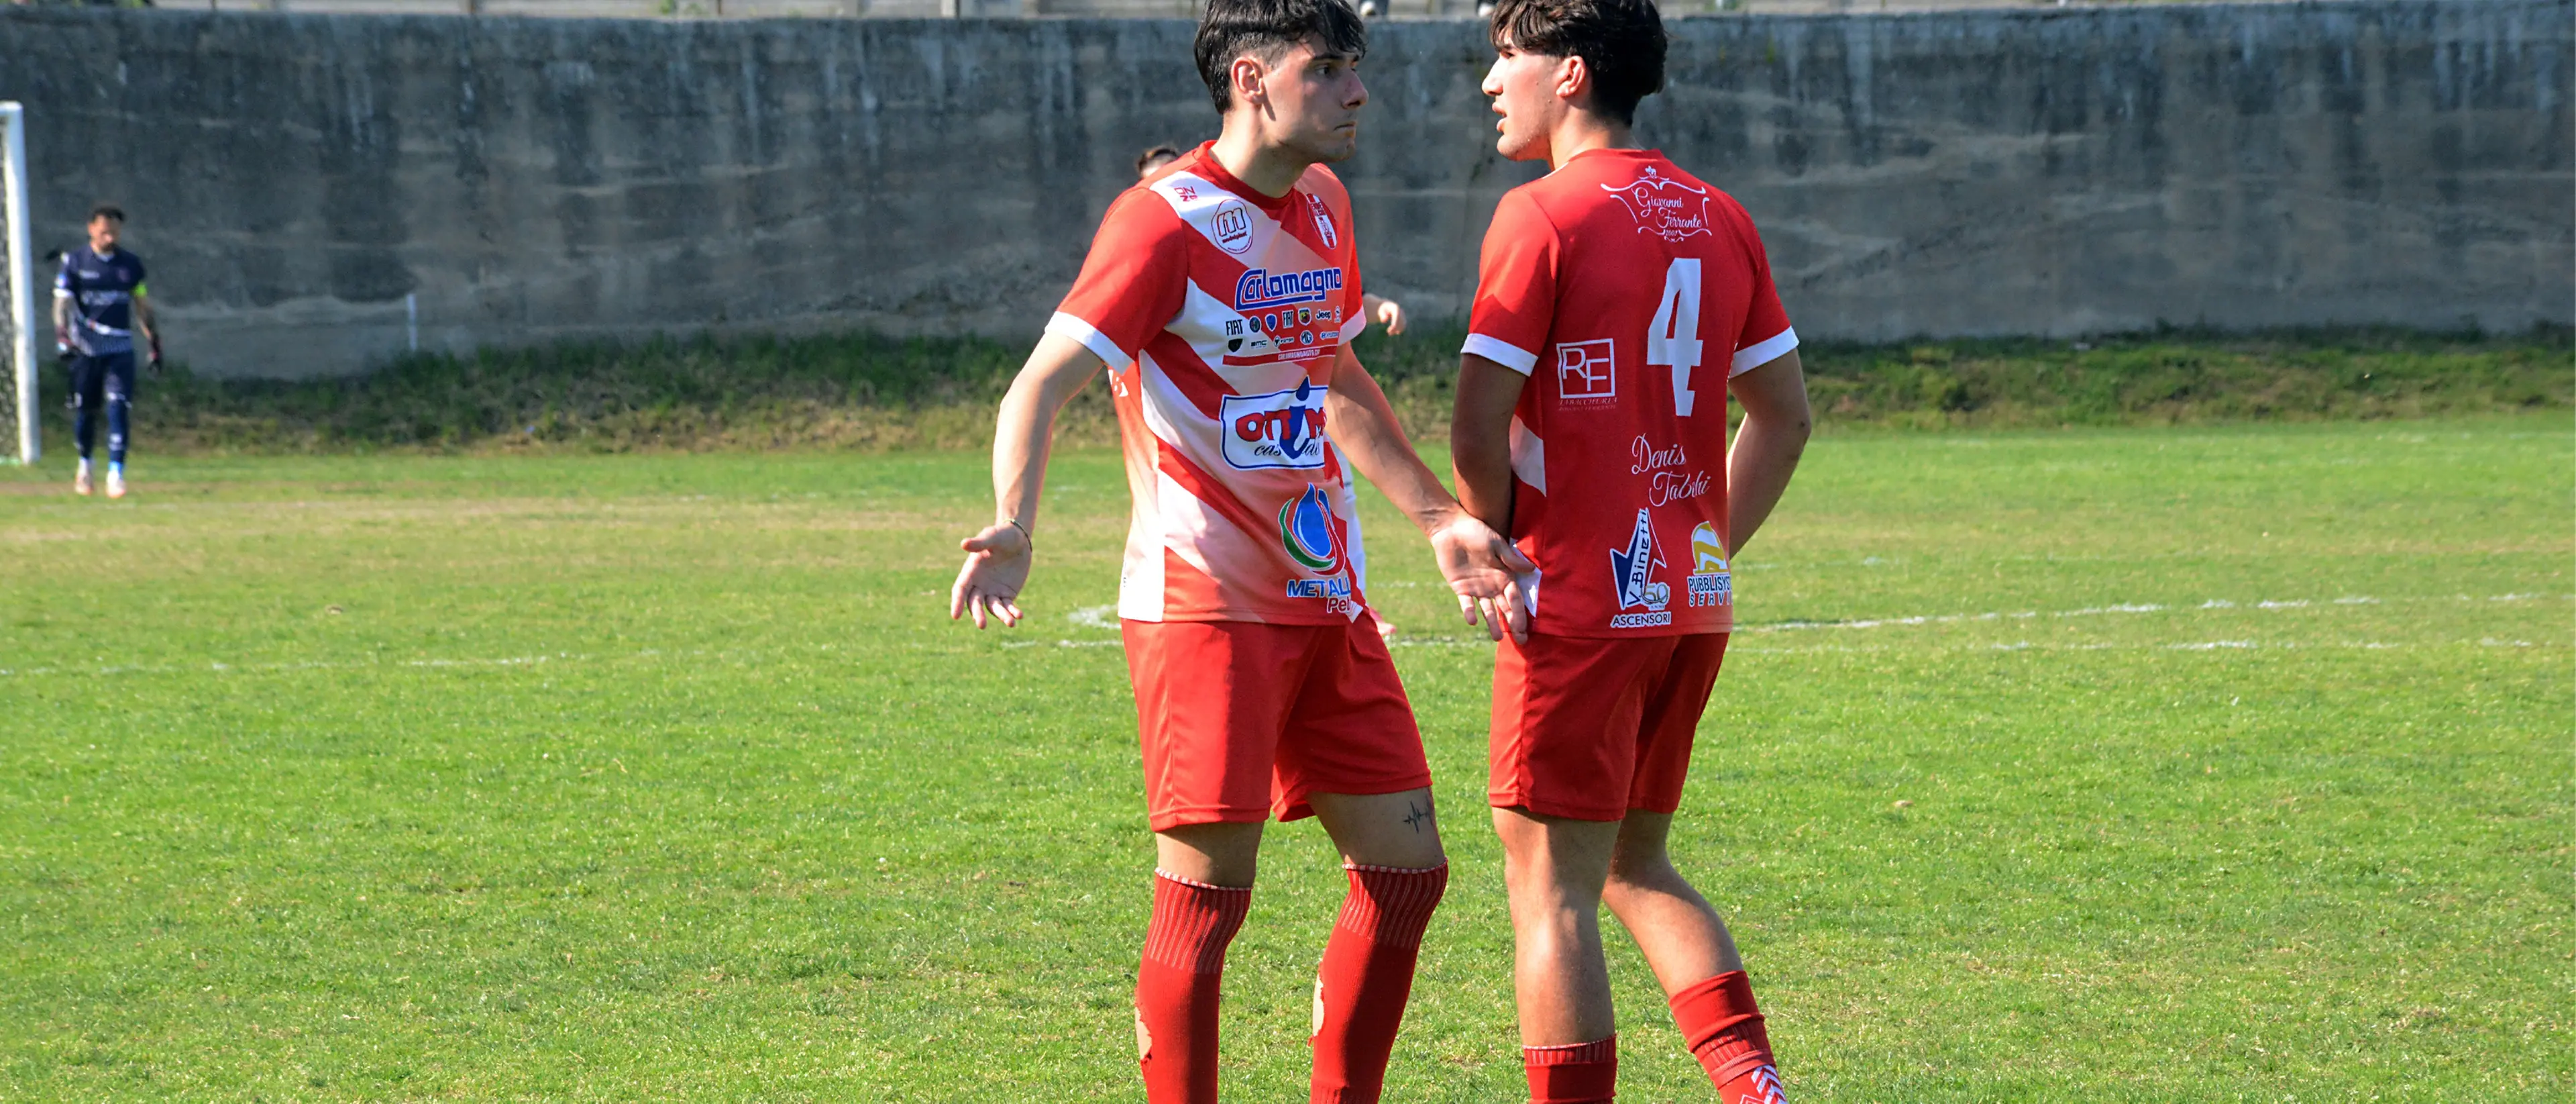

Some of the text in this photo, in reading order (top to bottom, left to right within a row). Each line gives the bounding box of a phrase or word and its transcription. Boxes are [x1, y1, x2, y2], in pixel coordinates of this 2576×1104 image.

[1631, 187, 1683, 217] Giovanni
[1656, 207, 1701, 228] Ferrante
[1236, 268, 1342, 311] Carlomagno
[1226, 319, 1243, 336] FIAT
[1283, 311, 1293, 327] FIAT
[1316, 309, 1332, 319] Jeep
[1647, 258, 1703, 417] 4
[1562, 348, 1609, 391] RF
[1631, 432, 1686, 474] Denis
[1631, 510, 1650, 589] Binetti
[1612, 613, 1670, 626] ASCENSORI
